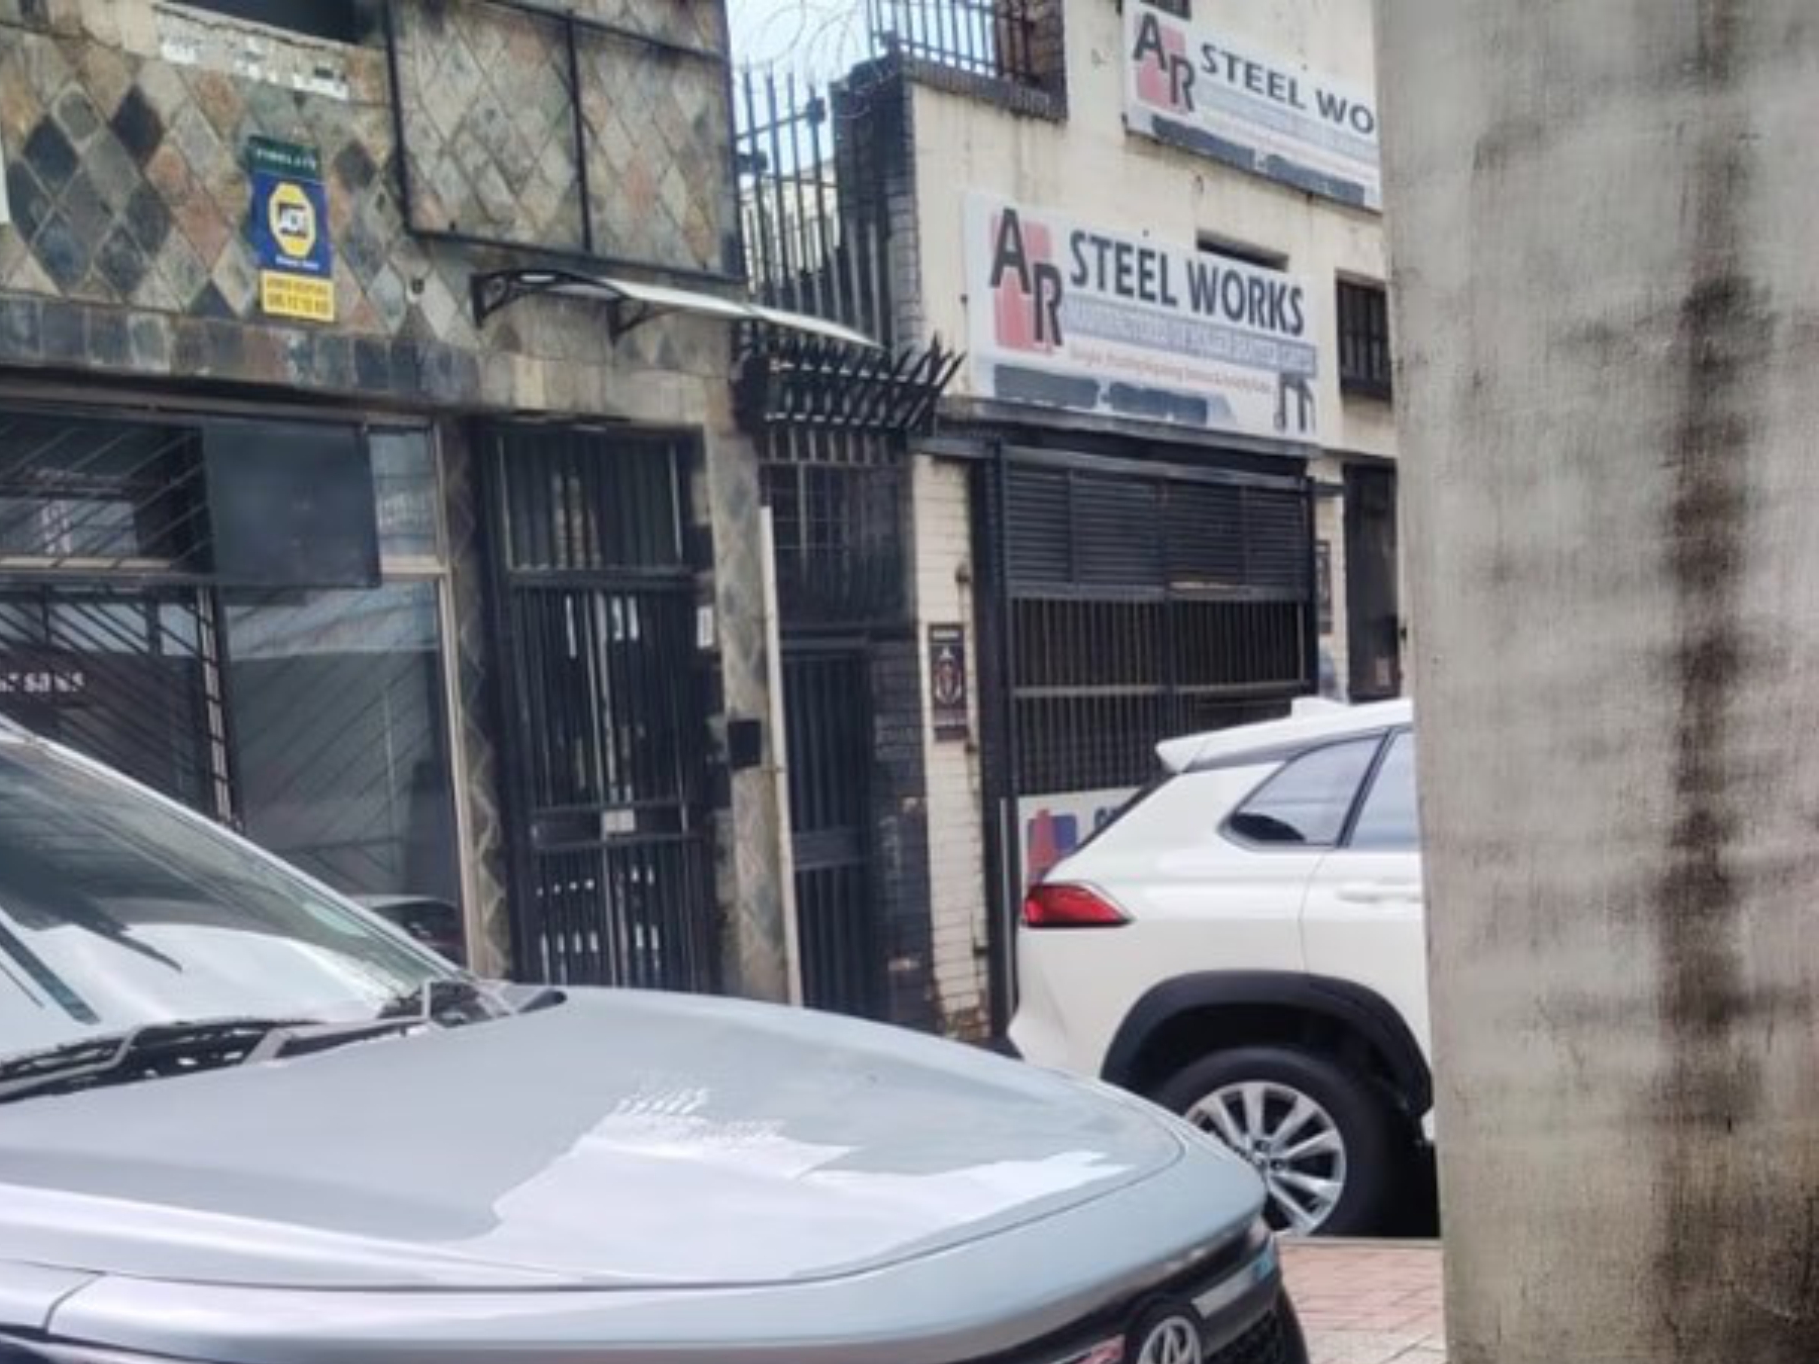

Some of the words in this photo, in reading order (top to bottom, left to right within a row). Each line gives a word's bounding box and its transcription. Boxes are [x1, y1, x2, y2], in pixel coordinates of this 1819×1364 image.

[1201, 43, 1307, 109] STEEL
[1315, 87, 1375, 134] WO
[1069, 230, 1178, 308] STEEL
[1186, 253, 1305, 337] WORKS
